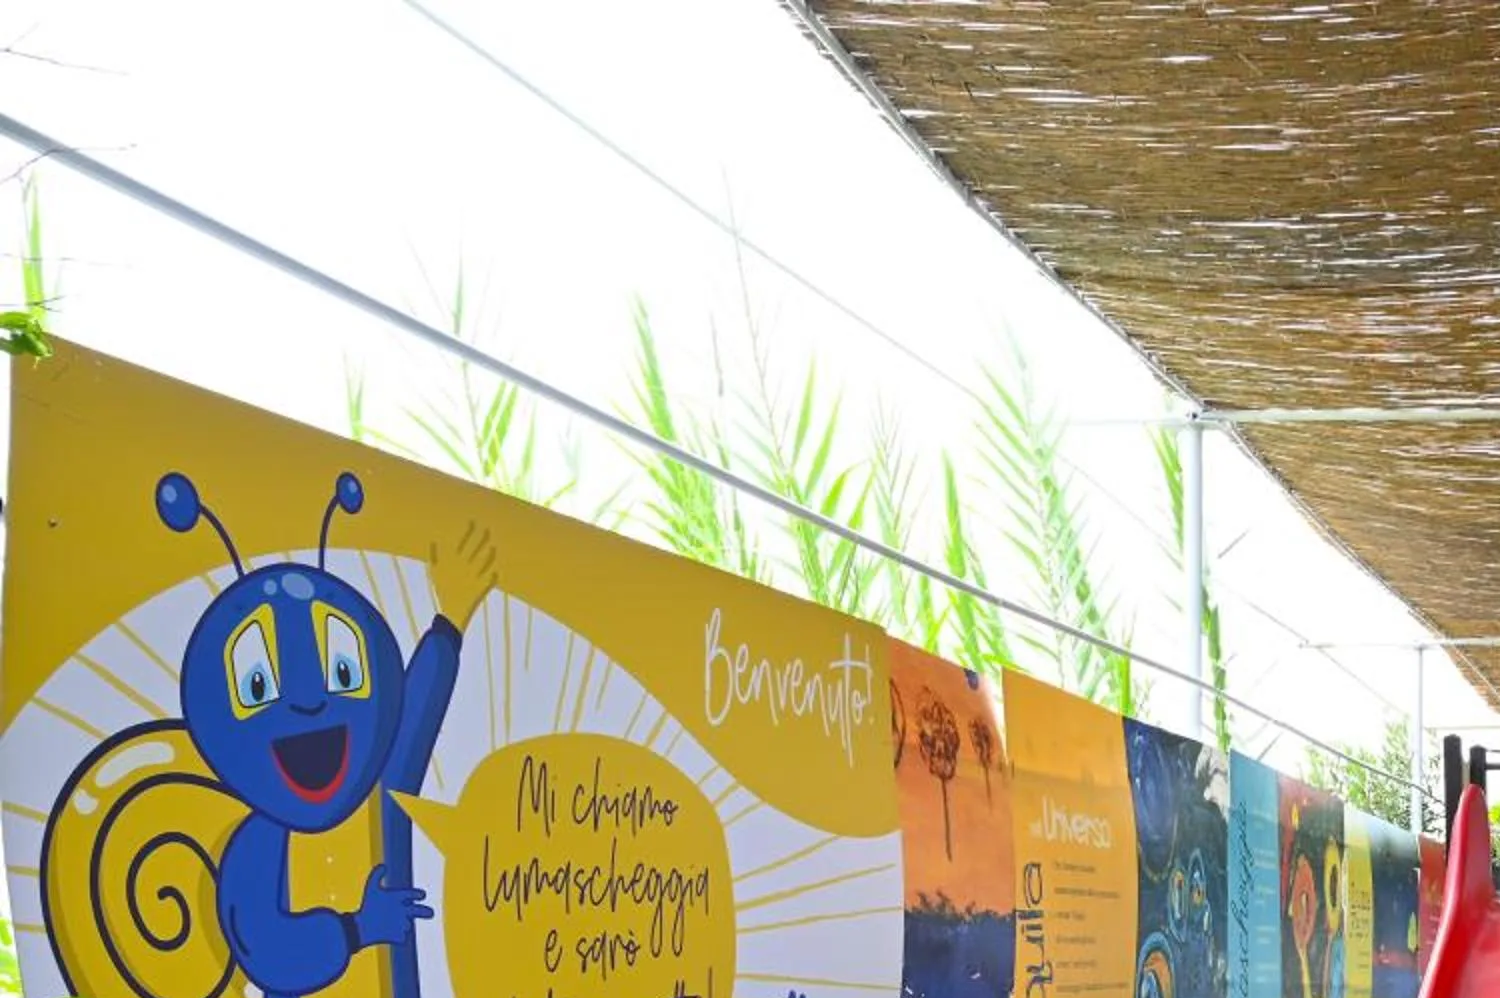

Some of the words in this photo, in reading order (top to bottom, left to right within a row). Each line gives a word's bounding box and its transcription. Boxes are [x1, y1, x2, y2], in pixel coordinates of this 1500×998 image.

[705, 607, 873, 769] Benvenuto!
[516, 754, 558, 839] Mi
[572, 756, 680, 838] chiamo
[544, 929, 563, 973] e
[576, 929, 641, 982] sarò
